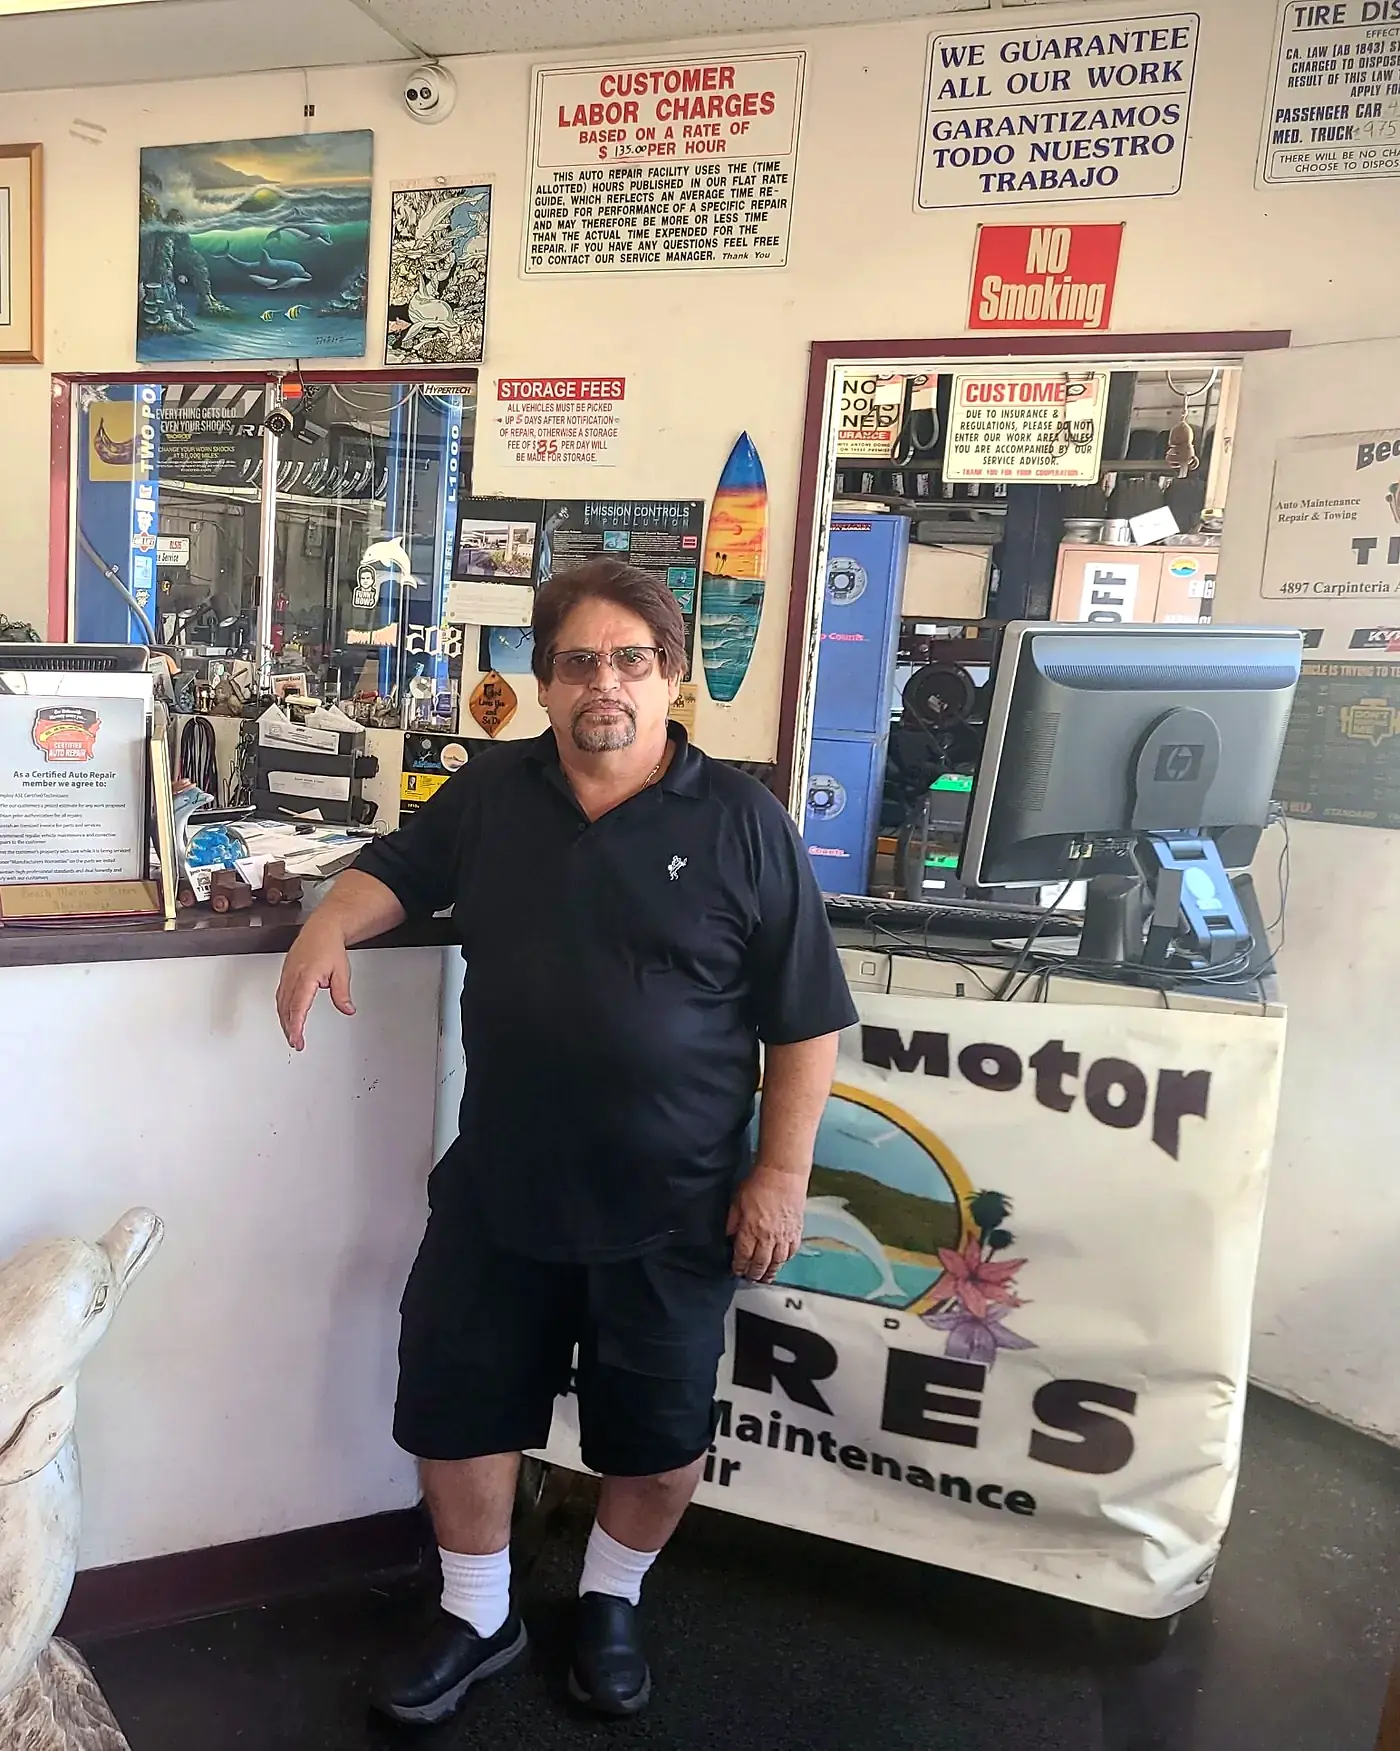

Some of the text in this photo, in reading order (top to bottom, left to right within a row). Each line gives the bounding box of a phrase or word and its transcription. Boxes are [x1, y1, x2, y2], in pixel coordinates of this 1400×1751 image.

[1295, 4, 1347, 27] TIRE
[940, 27, 1189, 68] WE GUARANTEE
[1286, 49, 1301, 59] CA.
[1308, 47, 1327, 58] LAW
[1292, 60, 1336, 73] CHARGED
[1342, 59, 1353, 70] TO
[600, 66, 736, 98] CUSTOMER
[937, 60, 1183, 100] ALL OUR WORK
[1288, 70, 1393, 88] RESULT OF THIS LAW
[1350, 86, 1380, 97] APPLY
[558, 92, 775, 127] LABOR CHARGES
[1275, 103, 1382, 123] PASSENGER CAR
[932, 104, 1180, 141] GARANTIZAMOS
[579, 122, 750, 144] BASED ON A RATE OF
[1272, 126, 1353, 144] MED. TRUCK
[599, 146, 607, 160] $
[648, 143, 676, 156] PER
[685, 140, 726, 153] HOUR
[933, 133, 1174, 168] TODO NUESTRO
[1280, 154, 1309, 162] THERE
[1316, 153, 1337, 161] WILL
[1359, 150, 1376, 158] NO
[554, 161, 780, 181] THIS AUTO REPAIR FACILITY USES THE (TIME
[1295, 163, 1338, 173] CHOOSE
[1344, 162, 1357, 170] TO
[979, 166, 1118, 192] TRABAJO
[531, 251, 770, 266] TO CONTACT OUR SERVICE MANAGER. Thank You
[1026, 228, 1071, 274] NO
[979, 276, 1105, 328] Smoking
[424, 385, 471, 394] HYPERTECH
[501, 381, 622, 398] STORAGE FEES
[966, 383, 1066, 402] CUSTOME
[587, 403, 612, 411] PICKED
[966, 410, 1058, 418] DUE TO INSURANCE &
[505, 416, 514, 424] UP
[524, 416, 542, 424] DAYS
[543, 416, 564, 424] AFTER
[567, 416, 613, 424] NOTIFICATION
[960, 421, 1017, 431] REGULATIONS,
[1023, 421, 1052, 429] PLEASE
[141, 384, 156, 472] TWO PO
[500, 428, 617, 438] OF REPAIR, OTHERWISE A STORAGE
[955, 433, 979, 441] ENTER
[984, 433, 1000, 441] OUR
[1007, 433, 1031, 441] WORK
[508, 441, 520, 449] FEE
[522, 441, 532, 449] OF
[562, 441, 574, 449] PER
[577, 441, 590, 449] DAY
[591, 441, 607, 449] WILL
[955, 445, 970, 453] YOU
[975, 445, 990, 453] ARE
[996, 445, 1053, 453] ACCOMPANIED
[1075, 445, 1092, 453] OUR
[516, 453, 525, 461] BE
[527, 453, 545, 461] MADE
[1020, 457, 1058, 465] ADVISOR.
[585, 504, 689, 517] EMISSION CONTROLS
[1276, 499, 1361, 510] Auto Maintenance
[1278, 511, 1357, 523] Repair & Towing
[1280, 581, 1390, 596] 4897 Carpinteria
[355, 598, 375, 607] HOW?
[405, 623, 463, 658] 208
[90, 771, 116, 780] Repair
[861, 1024, 1212, 1160] Motor
